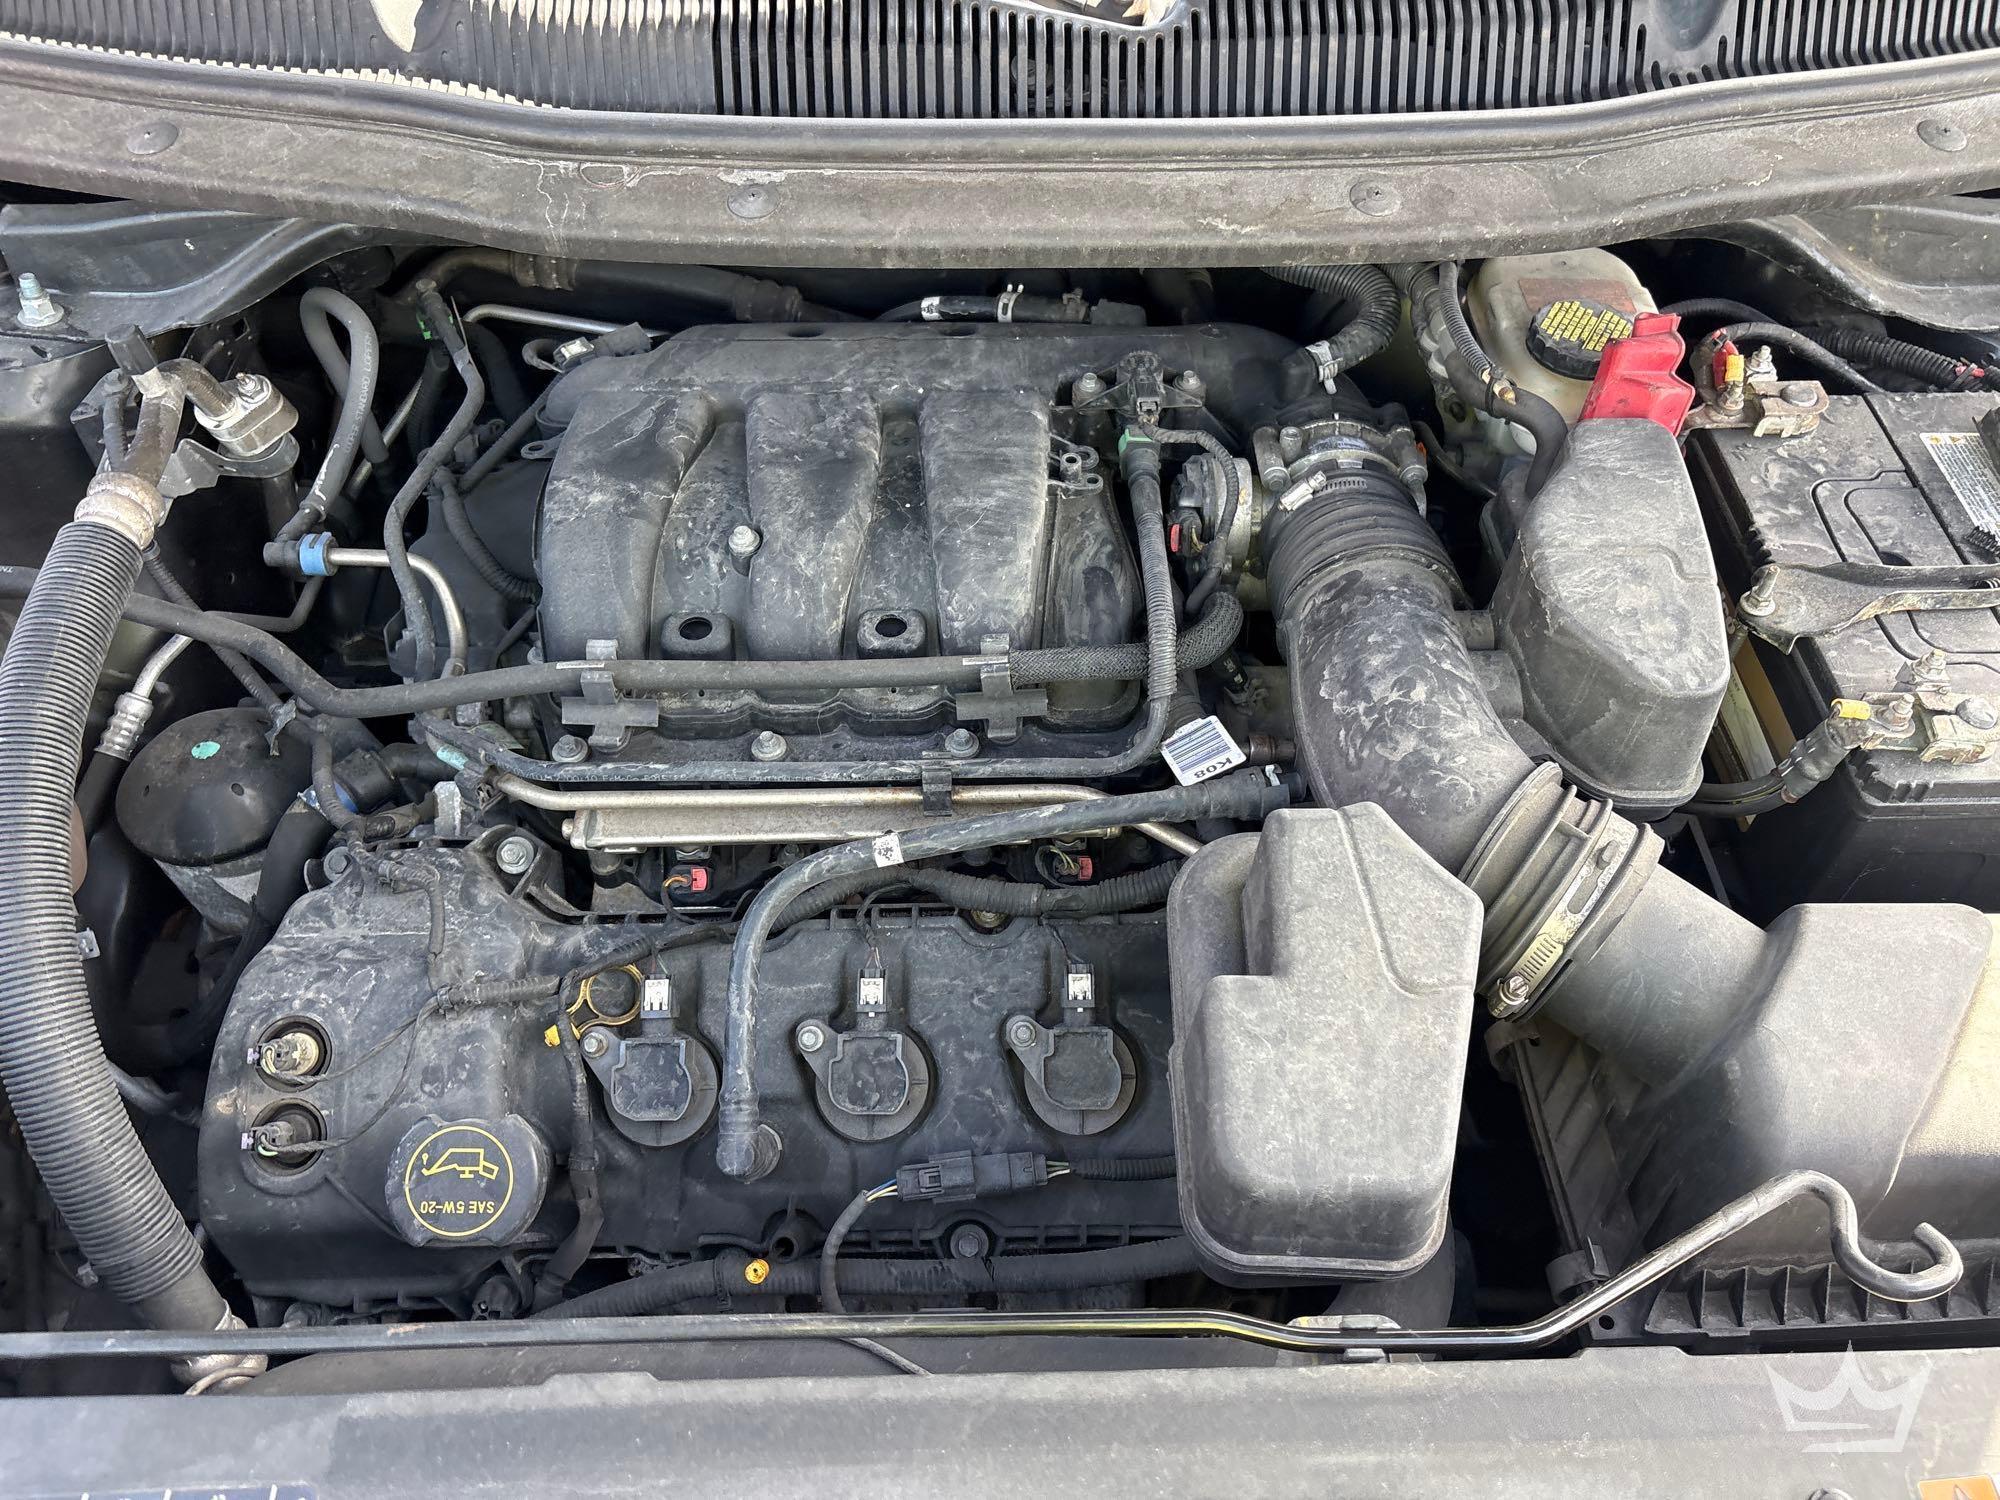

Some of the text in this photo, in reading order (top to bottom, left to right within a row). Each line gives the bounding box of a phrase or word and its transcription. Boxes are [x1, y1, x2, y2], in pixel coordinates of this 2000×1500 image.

[1194, 757, 1232, 778] K08
[420, 1200, 495, 1214] SAE 5W-20
